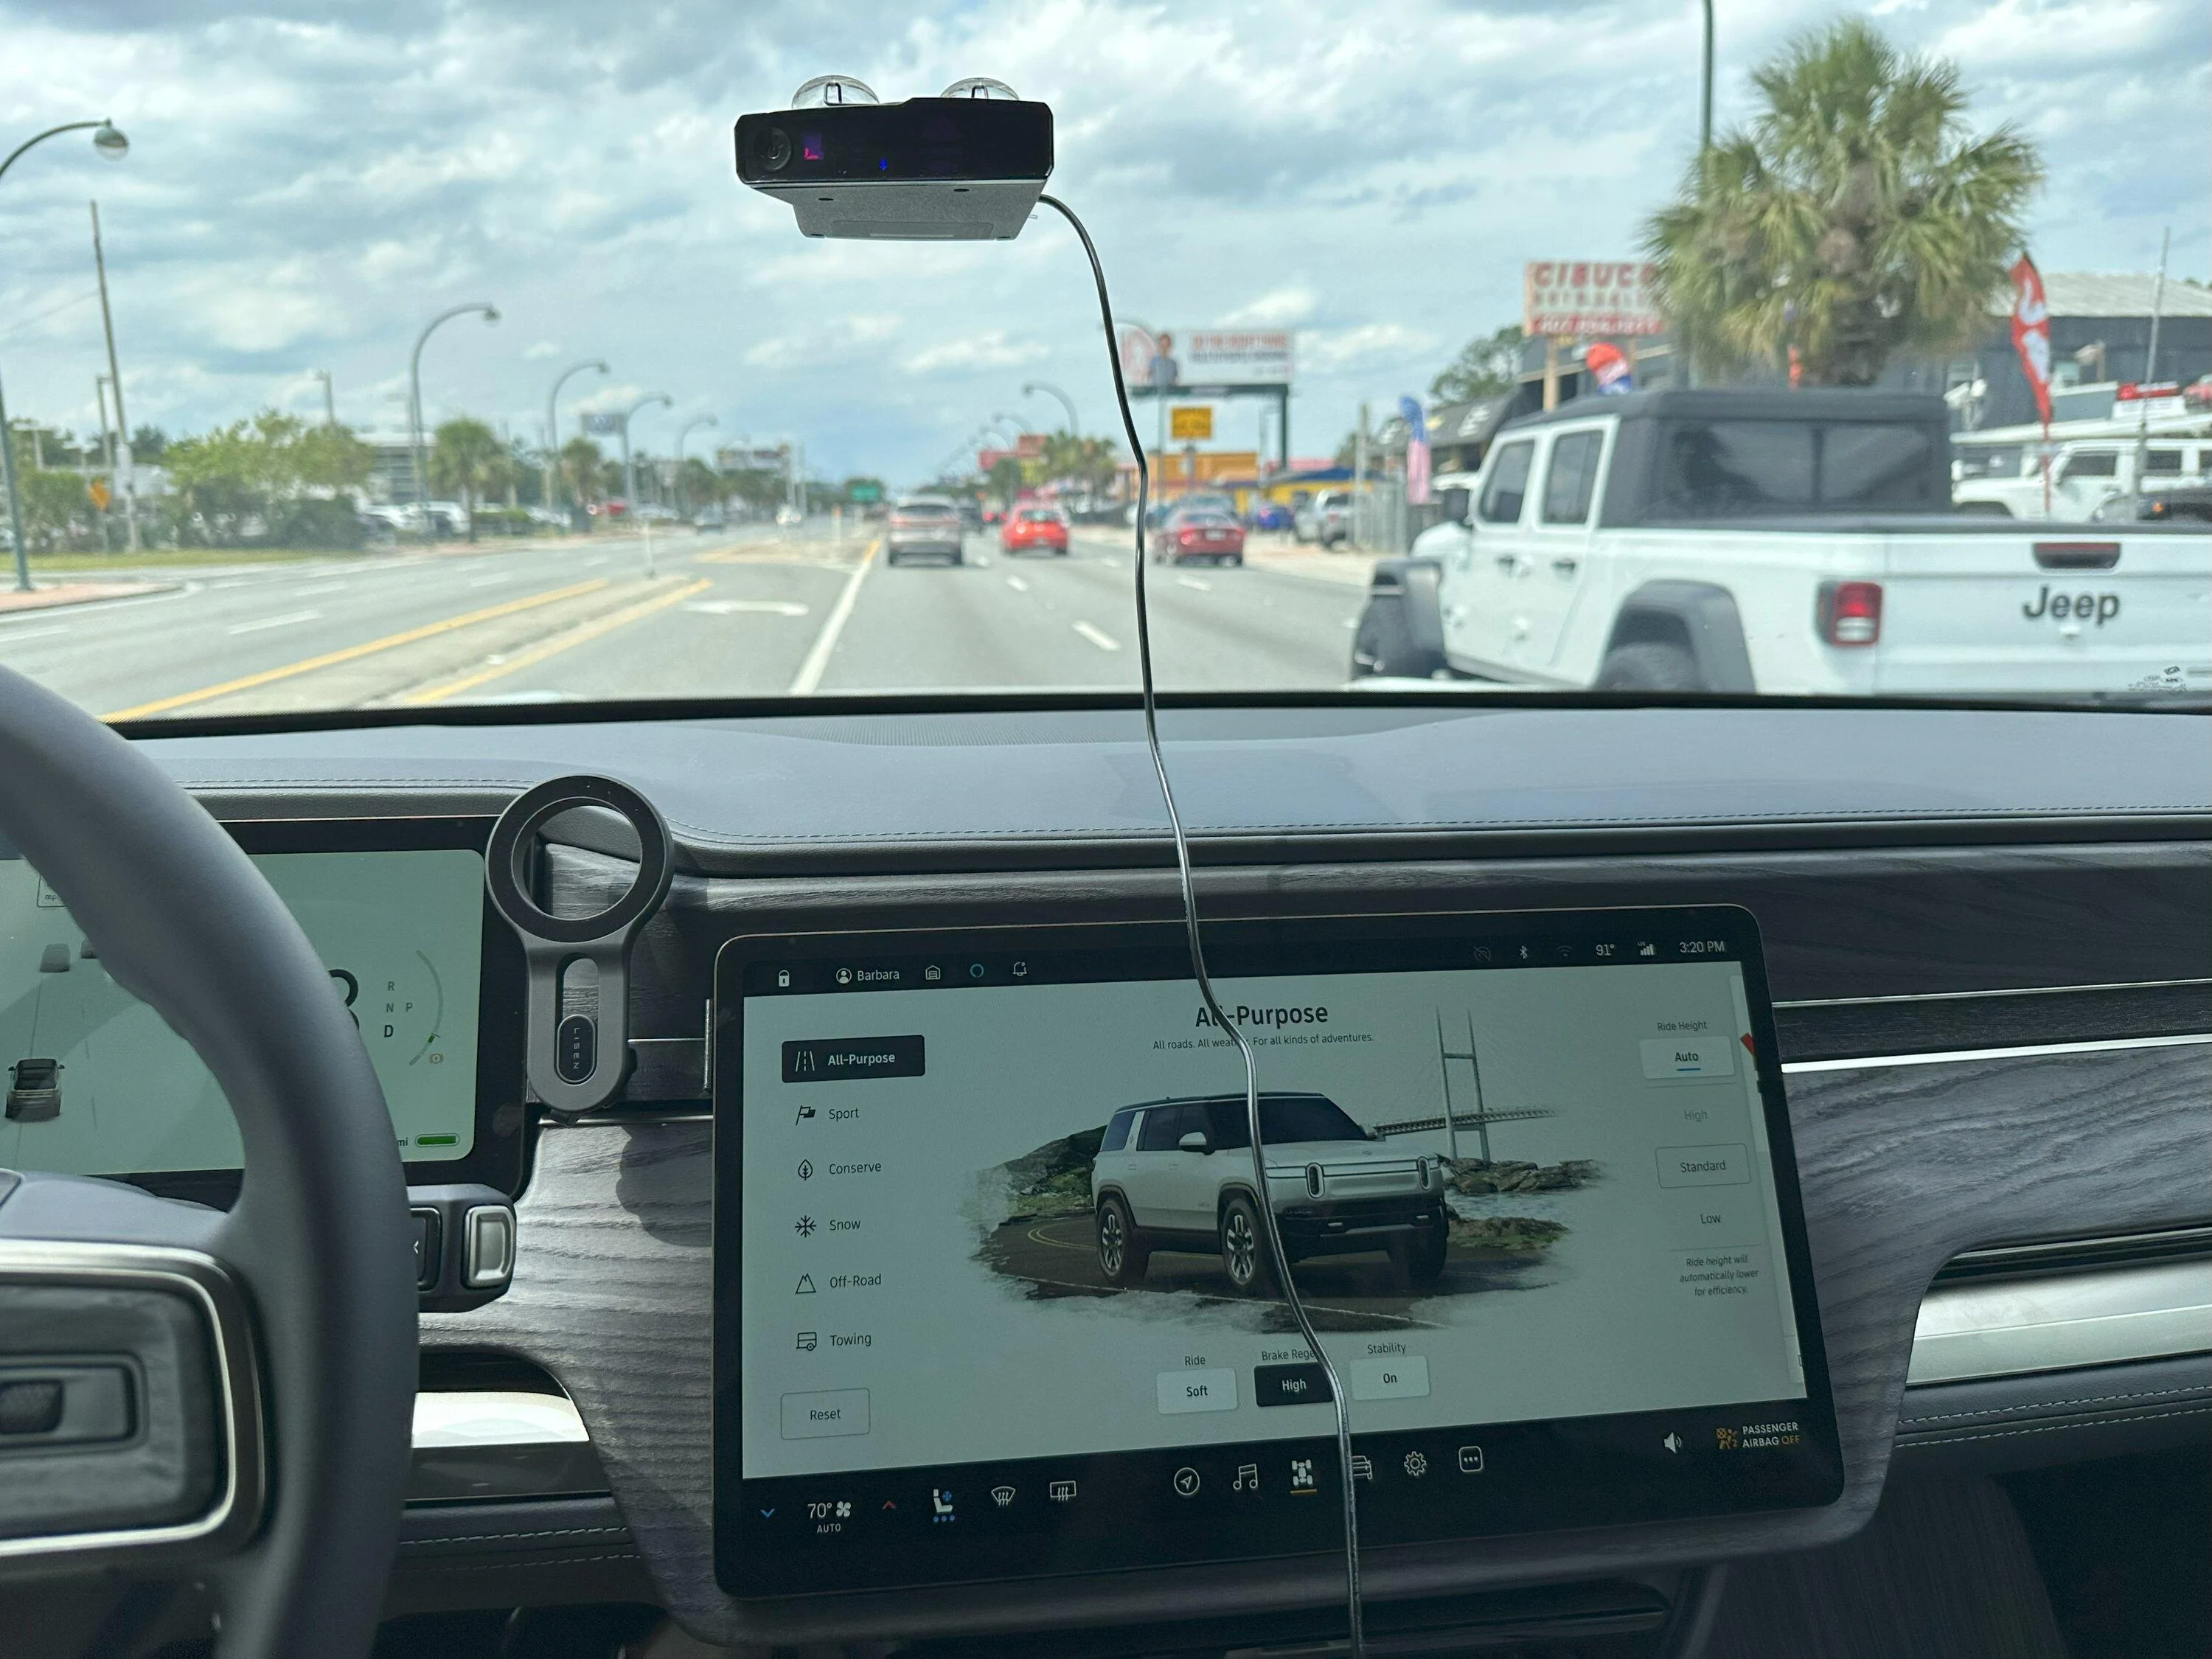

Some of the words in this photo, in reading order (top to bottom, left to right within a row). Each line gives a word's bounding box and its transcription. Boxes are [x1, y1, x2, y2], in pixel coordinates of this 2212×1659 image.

[2023, 585, 2121, 627] Jeep
[1596, 944, 1615, 956] 91°
[1679, 941, 1704, 953] 3:20
[1707, 940, 1725, 953] PM
[857, 970, 900, 981] Barbara
[387, 981, 395, 991] R
[386, 1003, 394, 1013] N
[406, 1002, 413, 1013] P
[1195, 1005, 1328, 1029] Al-Purpose
[383, 1024, 394, 1038] D
[1657, 1022, 1677, 1032] Ride
[1678, 1020, 1708, 1031] Height
[1152, 1040, 1166, 1049] All
[1168, 1039, 1195, 1049] roads.
[1197, 1038, 1210, 1048] All
[1253, 1037, 1267, 1046] For
[1270, 1036, 1281, 1046] all
[1284, 1035, 1308, 1045] kinds
[1310, 1034, 1320, 1044] of
[1321, 1033, 1374, 1044] adventures.
[828, 1054, 896, 1066] All-Purpose
[1674, 1052, 1699, 1062] Auto
[829, 1108, 860, 1121] Sport
[1684, 1110, 1708, 1122] High
[829, 1163, 882, 1175] Conserve
[1680, 1160, 1726, 1172] Standard
[1700, 1214, 1721, 1224] Low
[830, 1220, 861, 1231] Snow
[1686, 1257, 1704, 1267] Ride
[1705, 1256, 1732, 1267] height
[1734, 1254, 1748, 1264] will
[830, 1273, 882, 1288] Off-Road
[1679, 1270, 1733, 1282] automatically
[1736, 1269, 1759, 1279] lower
[1694, 1287, 1705, 1296] for
[1708, 1285, 1747, 1295] efficiency.
[830, 1332, 872, 1346] Towing
[1367, 1342, 1407, 1354] Stability
[1184, 1355, 1206, 1366] Ride
[1262, 1350, 1289, 1361] Brake
[1291, 1349, 1315, 1360] Rege
[1382, 1373, 1397, 1384] On
[1186, 1385, 1208, 1397] Soft
[1281, 1379, 1307, 1393] High
[810, 1408, 841, 1421] Reset
[1742, 1422, 1798, 1435] PASSENGER
[1742, 1436, 1779, 1448] AIRBAG
[1781, 1435, 1800, 1445] OFF
[807, 1502, 832, 1519] 70°
[816, 1523, 841, 1534] AUTO
